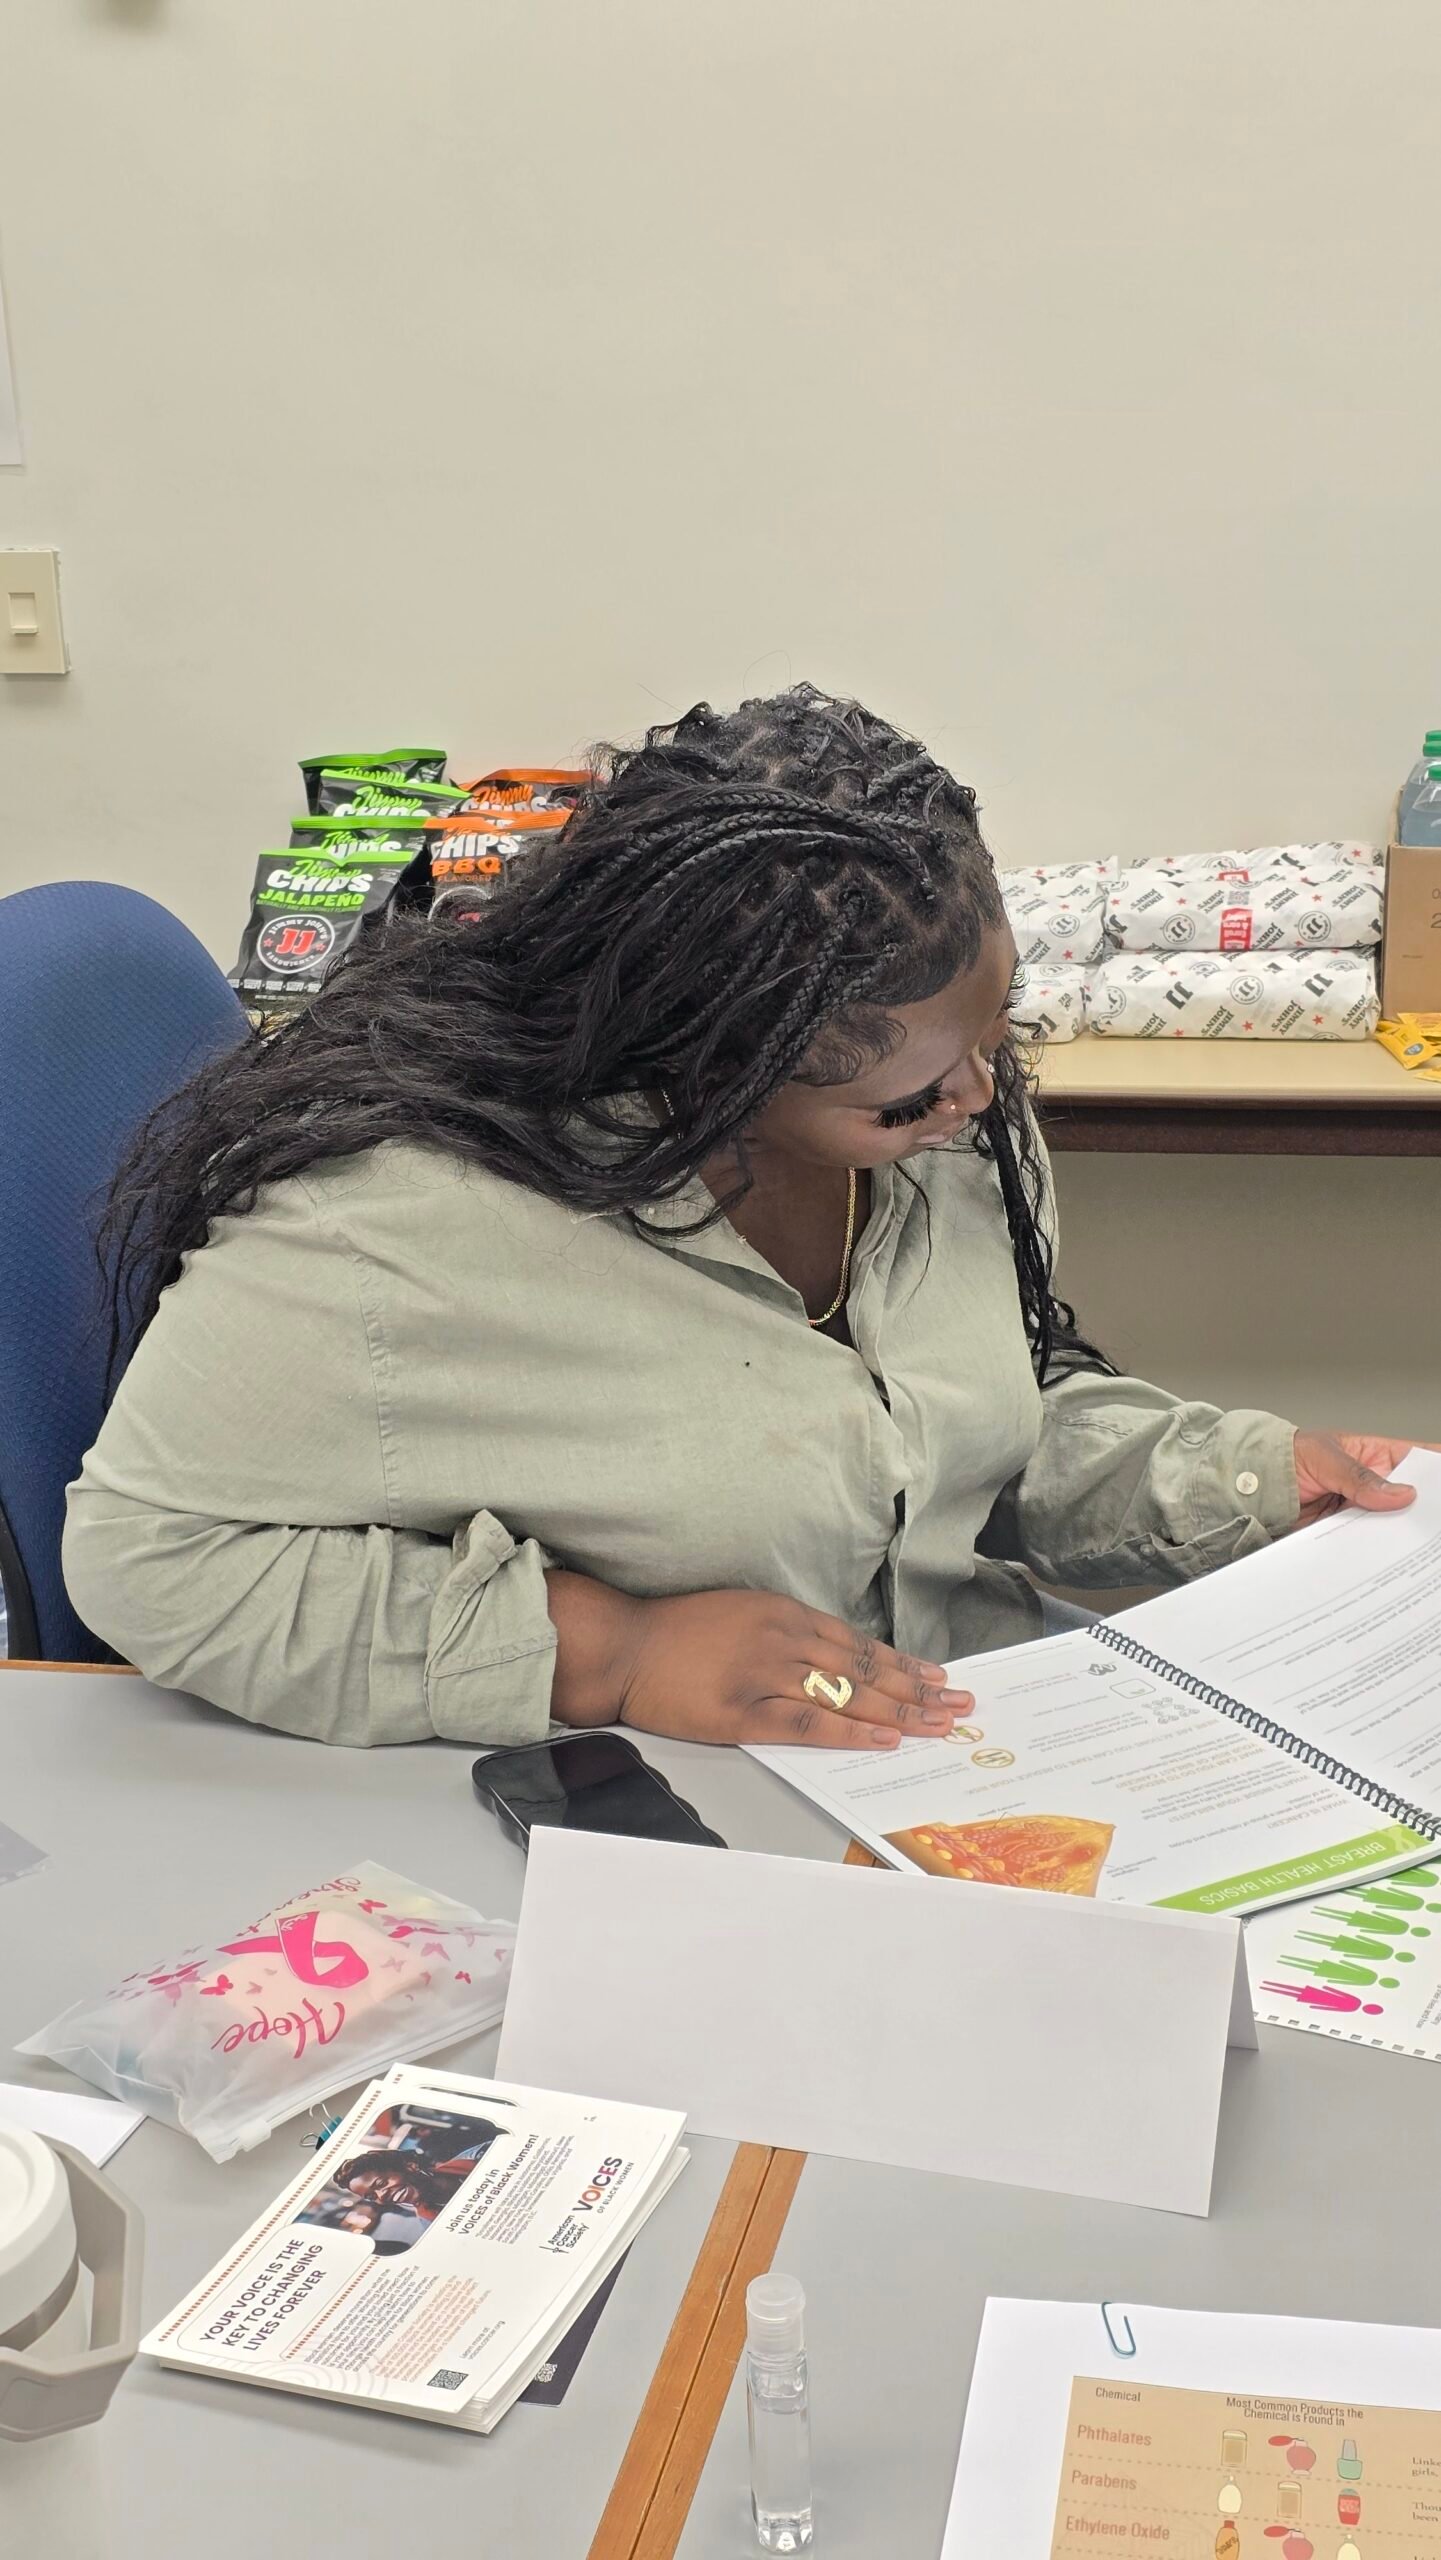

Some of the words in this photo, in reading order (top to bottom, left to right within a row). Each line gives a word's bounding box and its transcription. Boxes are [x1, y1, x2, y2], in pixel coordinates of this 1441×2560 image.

[473, 784, 533, 805] Jimmy
[432, 856, 501, 876] BBQ
[266, 869, 374, 892] CHIPS
[258, 888, 366, 907] JALAPEÑO
[275, 928, 317, 955] JJ
[1262, 929, 1285, 949] JIMM
[1323, 1841, 1385, 1868] BREAST
[1258, 1862, 1322, 1886] HEALTH
[1199, 1881, 1260, 1904] BASICS
[211, 1998, 346, 2059] Hope
[506, 2134, 539, 2170] Women!
[489, 2171, 513, 2195] Black
[572, 2157, 622, 2211] VOICES
[596, 2205, 605, 2214] OF
[602, 2186, 618, 2205] BLACK
[615, 2162, 634, 2185] WOMEN
[445, 2214, 465, 2232] Join
[460, 2203, 473, 2214] us
[467, 2177, 494, 2202] today
[485, 2169, 500, 2178] in
[484, 2195, 495, 2205] of
[458, 2205, 488, 2234] VOICES
[556, 2223, 578, 2247] Cancer
[565, 2223, 589, 2248] Society
[200, 2310, 239, 2340] YOUR
[231, 2274, 273, 2308] VOICE
[265, 2262, 283, 2273] IS
[275, 2239, 304, 2260] THE
[221, 2324, 250, 2346] KEY
[243, 2307, 266, 2322] TO
[261, 2245, 322, 2305] CHANGING
[243, 2320, 280, 2350] LIVES
[273, 2270, 326, 2319] FOREVER
[1095, 2386, 1141, 2402] Chemical
[1226, 2397, 1250, 2408] Most
[1254, 2400, 1298, 2412] Common
[1301, 2403, 1345, 2417] Products
[1348, 2408, 1364, 2419] the
[1244, 2408, 1290, 2421] Chemical
[1292, 2413, 1301, 2423] is
[1303, 2413, 1333, 2425] Found
[1336, 2418, 1345, 2426] in
[1077, 2424, 1152, 2446] Phthalates
[1072, 2469, 1137, 2490] Parabens
[1412, 2468, 1439, 2477] girls,
[1066, 2515, 1127, 2537] Ethylene
[1131, 2522, 1171, 2540] Oxide
[1412, 2512, 1439, 2522] been
